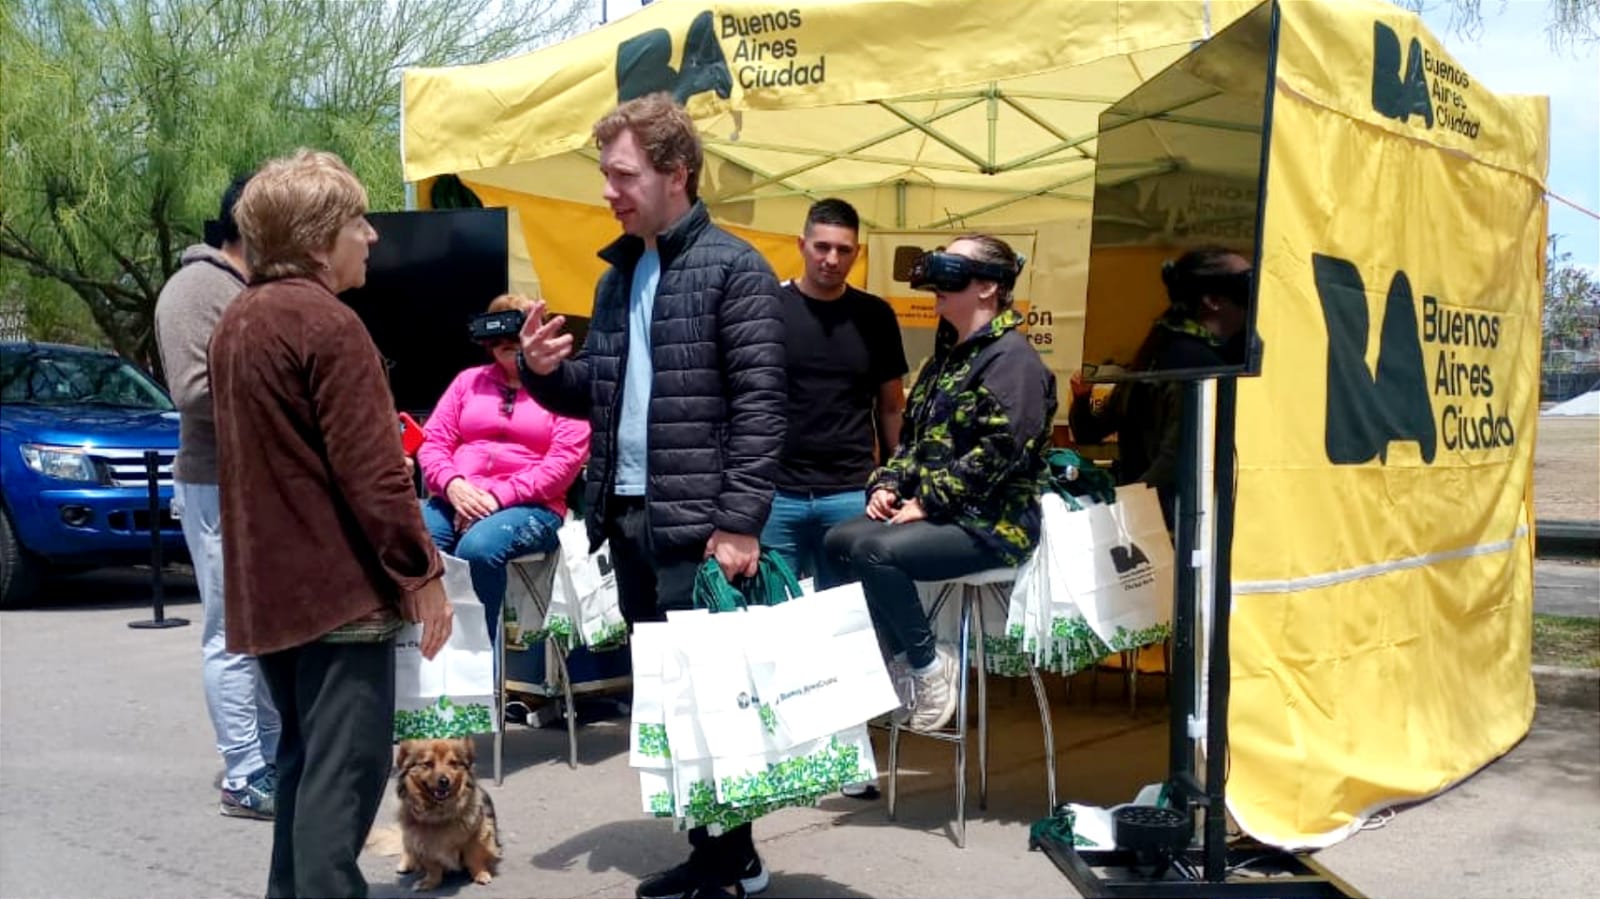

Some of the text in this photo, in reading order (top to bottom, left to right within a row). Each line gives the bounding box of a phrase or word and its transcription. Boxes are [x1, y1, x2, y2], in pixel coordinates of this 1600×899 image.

[721, 9, 802, 39] Buenos
[733, 38, 798, 63] Aires
[739, 56, 826, 90] Ciudad
[1424, 48, 1470, 89] Buenos
[1436, 105, 1481, 139] Ciudad
[1423, 295, 1501, 349] Buenos
[1434, 350, 1494, 398] Aires
